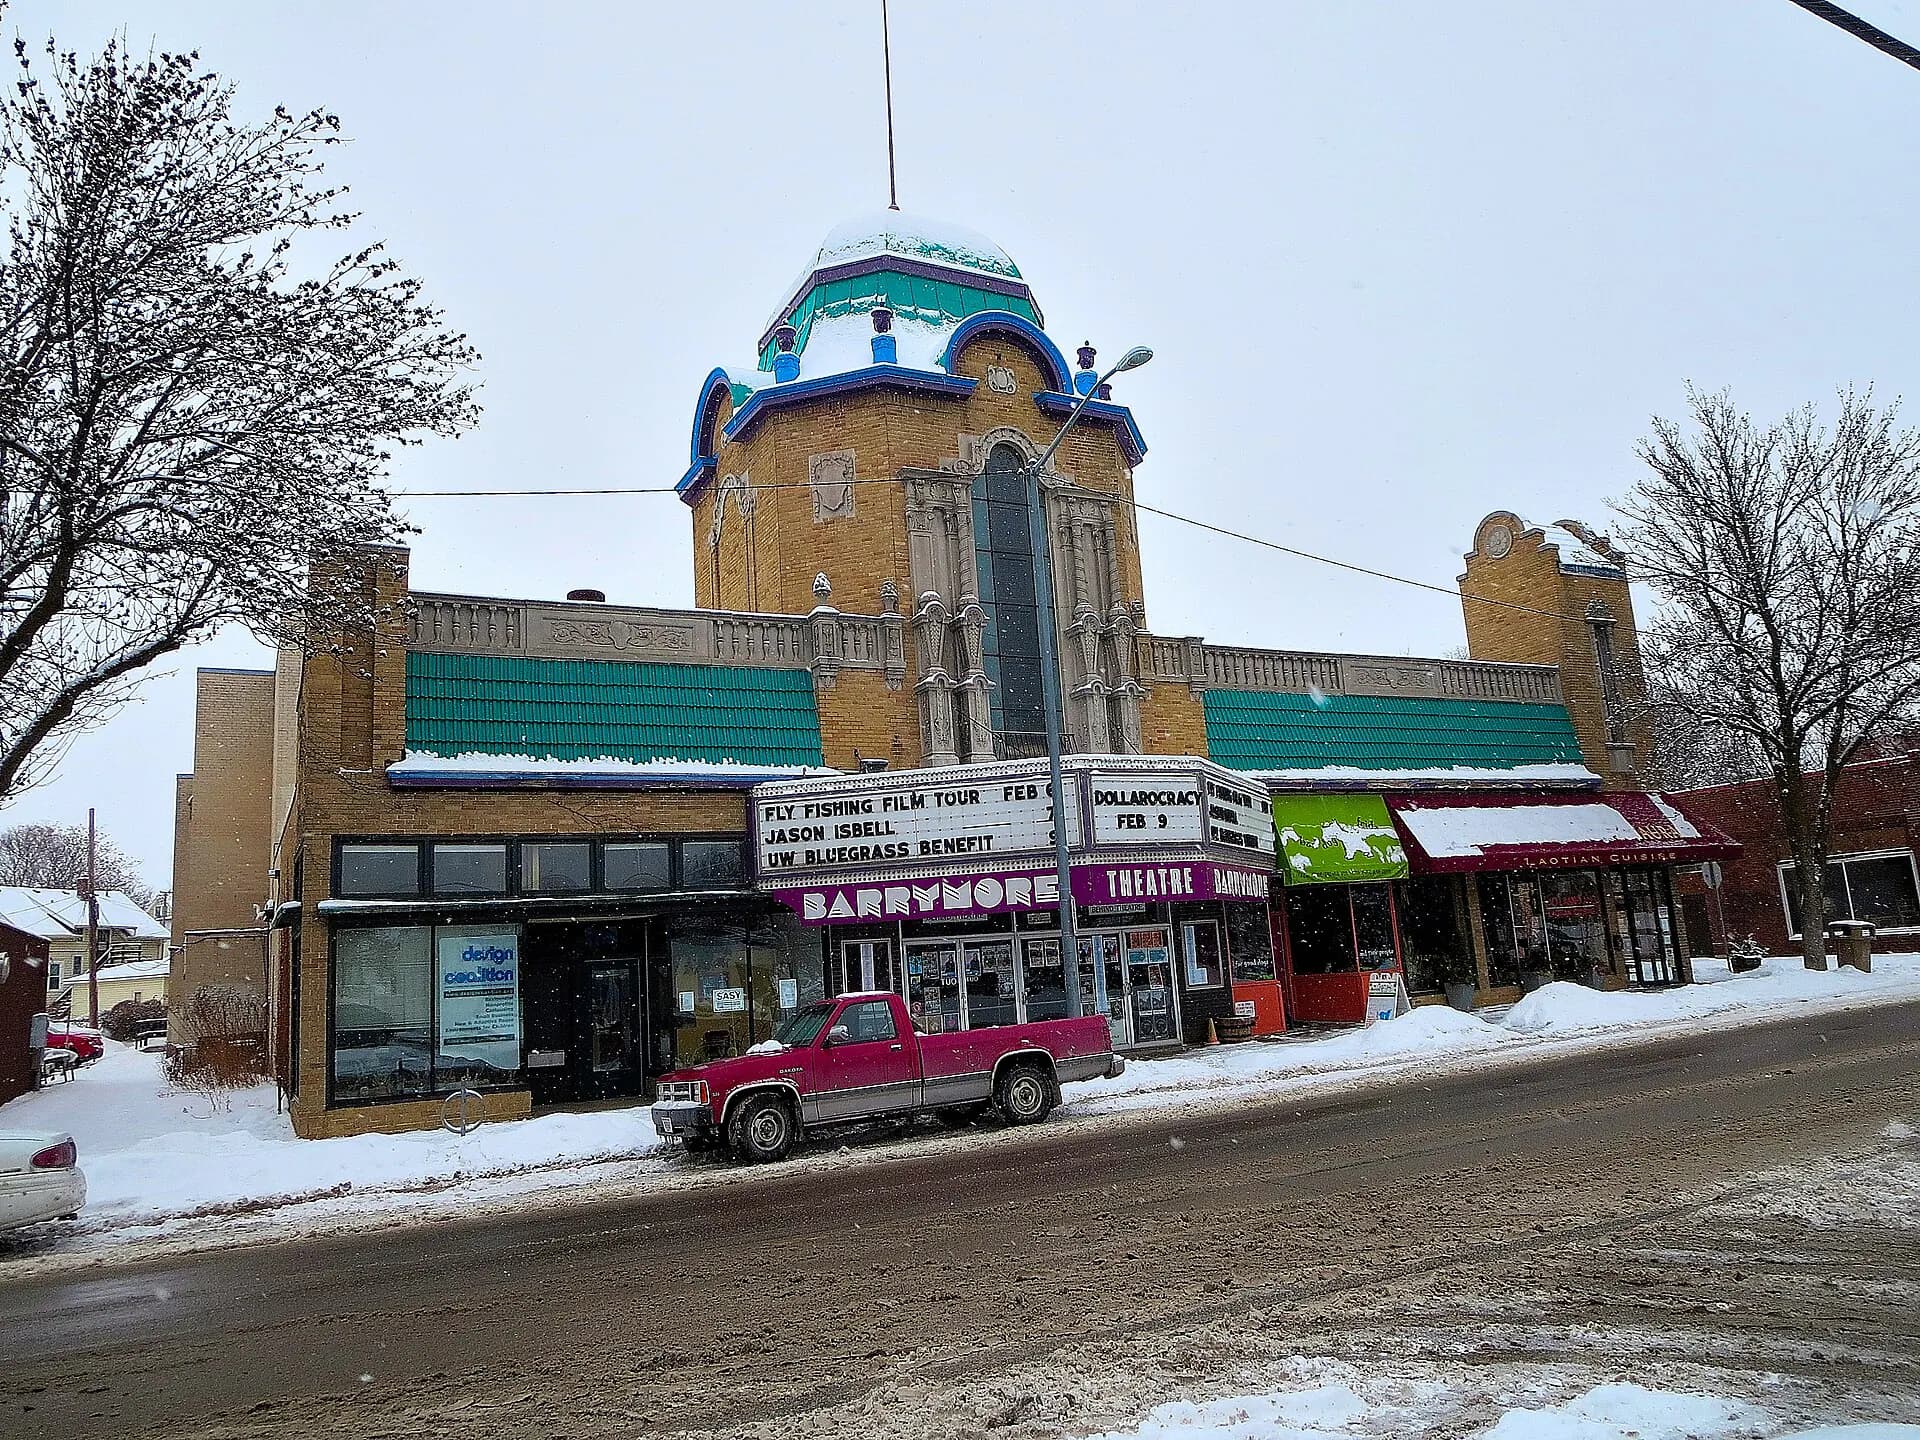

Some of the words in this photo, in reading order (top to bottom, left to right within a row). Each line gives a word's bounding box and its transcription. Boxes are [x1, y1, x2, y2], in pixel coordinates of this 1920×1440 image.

[764, 804, 795, 821] FLY
[804, 799, 873, 819] FISHING
[882, 791, 926, 812] FILM
[934, 789, 980, 808] TOUR
[1003, 784, 1038, 802] FEB
[1094, 790, 1202, 807] DOLLAROCRACY
[1117, 813, 1146, 829] FEB
[1157, 813, 1168, 829] 9
[765, 825, 825, 844] JASON
[834, 820, 895, 840] ISBELL
[767, 851, 795, 868] UW
[805, 842, 909, 866] BLUEGRASS
[919, 835, 994, 856] BENEFIT
[1524, 855, 1600, 866] LAOTIAN
[1610, 853, 1676, 862] CUISINE
[1106, 868, 1194, 898] THEATRE
[803, 874, 1060, 920] BARRYMORE
[462, 945, 514, 965] design
[444, 965, 514, 984] coalition
[716, 990, 741, 1000] SASY
